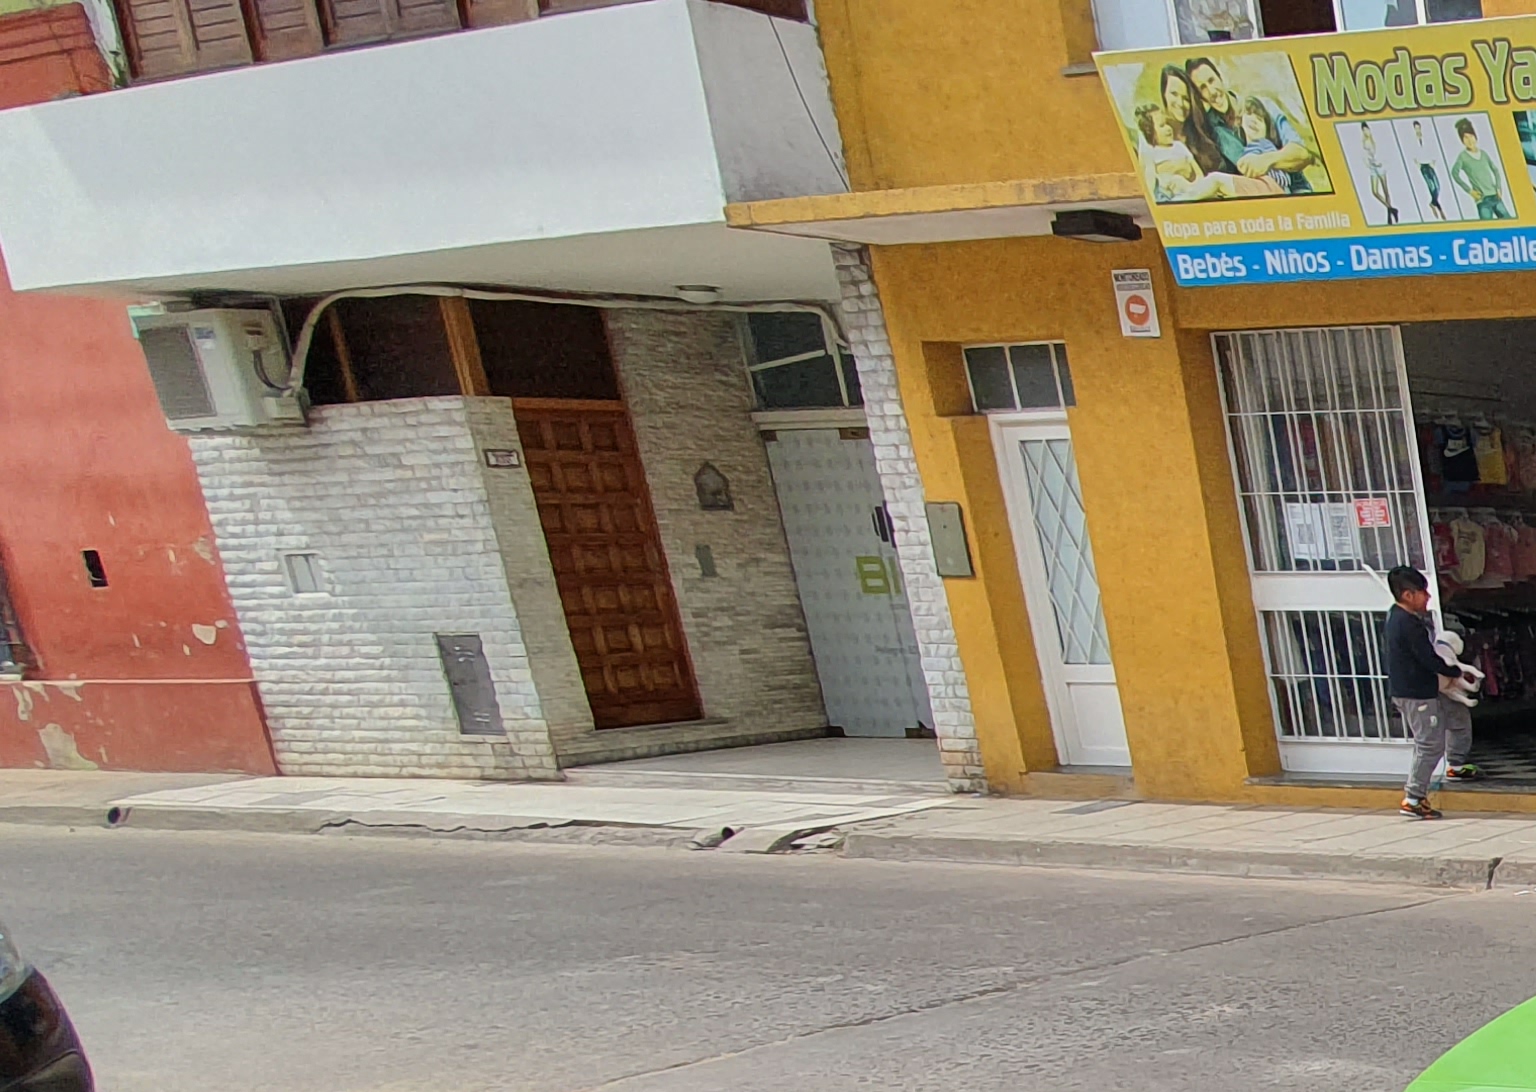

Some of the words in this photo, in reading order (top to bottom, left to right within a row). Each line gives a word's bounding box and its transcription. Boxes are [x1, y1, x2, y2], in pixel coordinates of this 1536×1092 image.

[1311, 47, 1473, 117] Modas
[1163, 220, 1200, 239] Ropa
[1204, 218, 1237, 238] para
[1241, 215, 1274, 234] toda
[1278, 216, 1293, 232] la
[1296, 211, 1350, 231] Familia
[1177, 252, 1247, 280] Bebés
[1264, 248, 1330, 276] Niños
[1350, 244, 1433, 272] Damas
